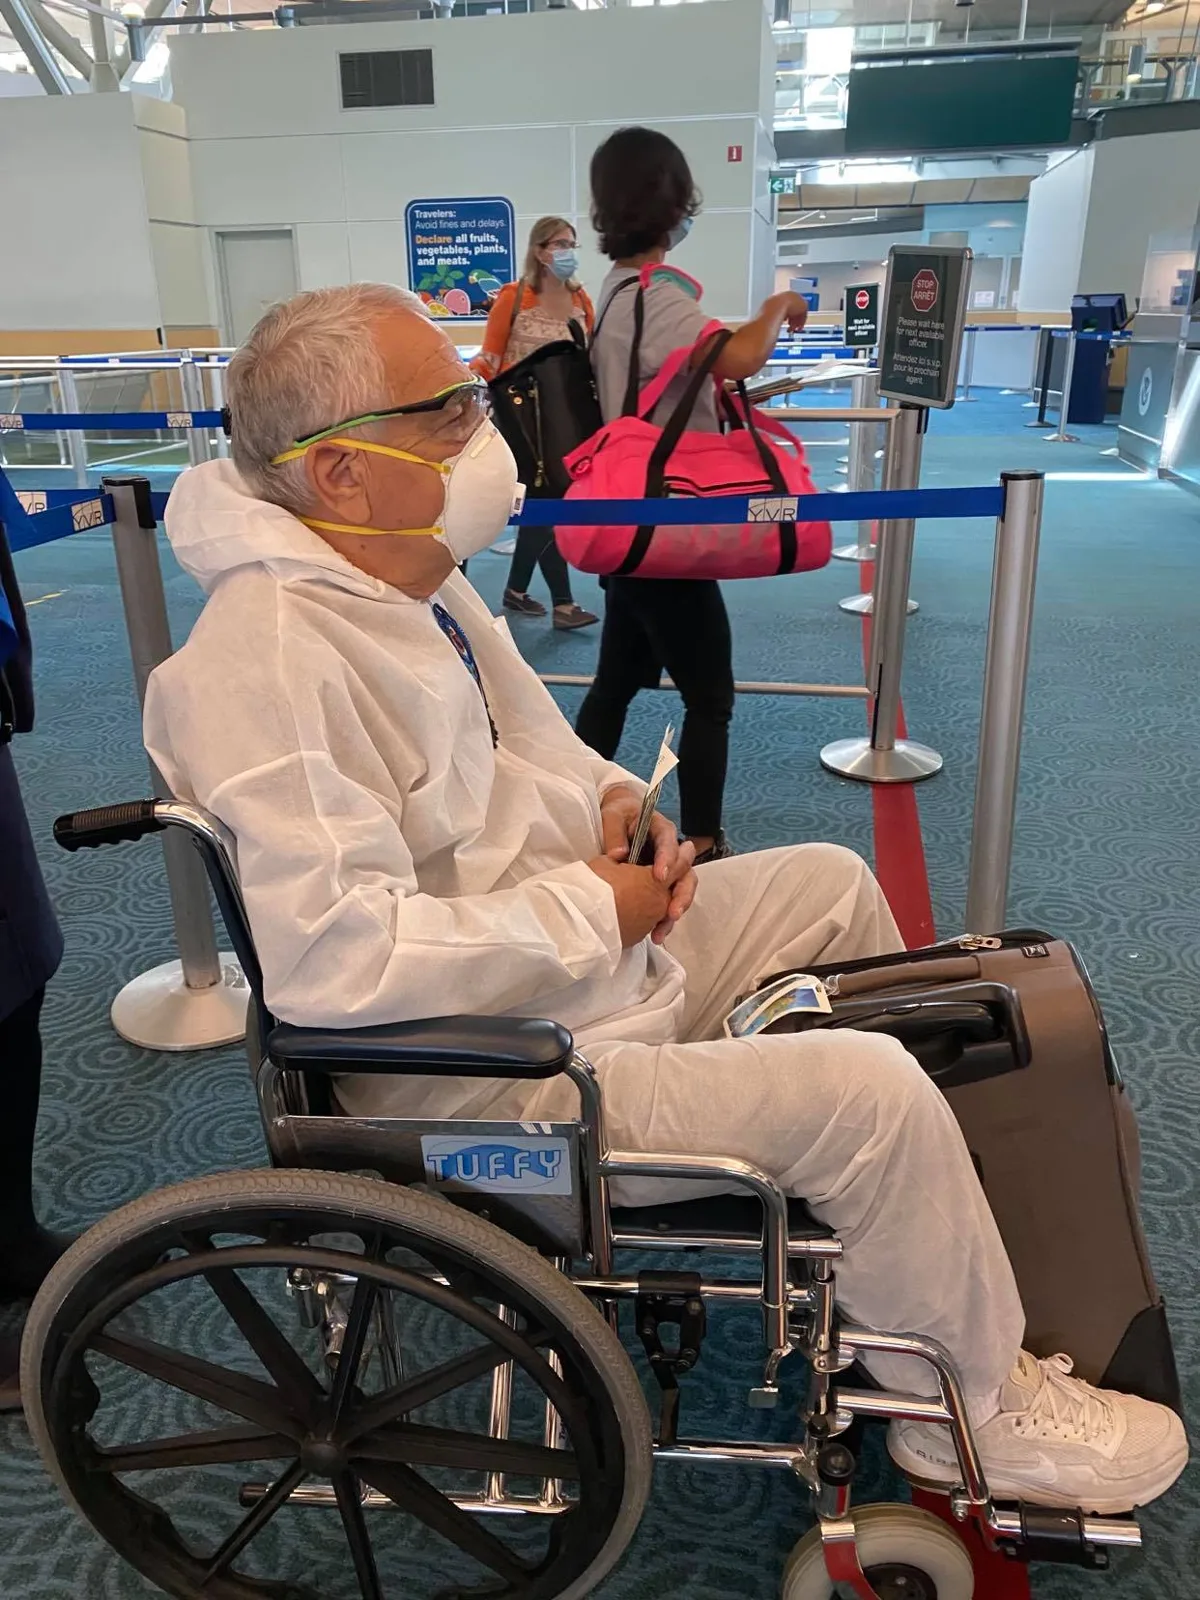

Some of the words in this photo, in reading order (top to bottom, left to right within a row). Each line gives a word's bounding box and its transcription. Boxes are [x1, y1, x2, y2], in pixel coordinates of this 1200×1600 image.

[414, 209, 457, 219] Travelers:
[415, 220, 438, 229] Avoid
[439, 219, 459, 229] fines
[460, 219, 476, 228] and
[415, 234, 453, 244] Declare
[455, 233, 468, 243] all
[469, 232, 499, 243] fruits,
[416, 244, 473, 256] vegetables,
[474, 243, 508, 255] plants,
[417, 256, 435, 266] and
[437, 255, 471, 265] meats.
[916, 279, 935, 289] STOP
[898, 316, 917, 327] Please
[918, 320, 931, 328] wait
[931, 320, 945, 330] here
[896, 326, 904, 335] for
[904, 329, 918, 337] next
[918, 330, 945, 341] available
[892, 353, 918, 364] Attendez
[892, 363, 907, 372] pour
[913, 367, 940, 377] prochain
[168, 418, 192, 427] YVR
[74, 510, 104, 529] YVR
[748, 507, 797, 521] YVR
[427, 1150, 562, 1181] TUFFY
